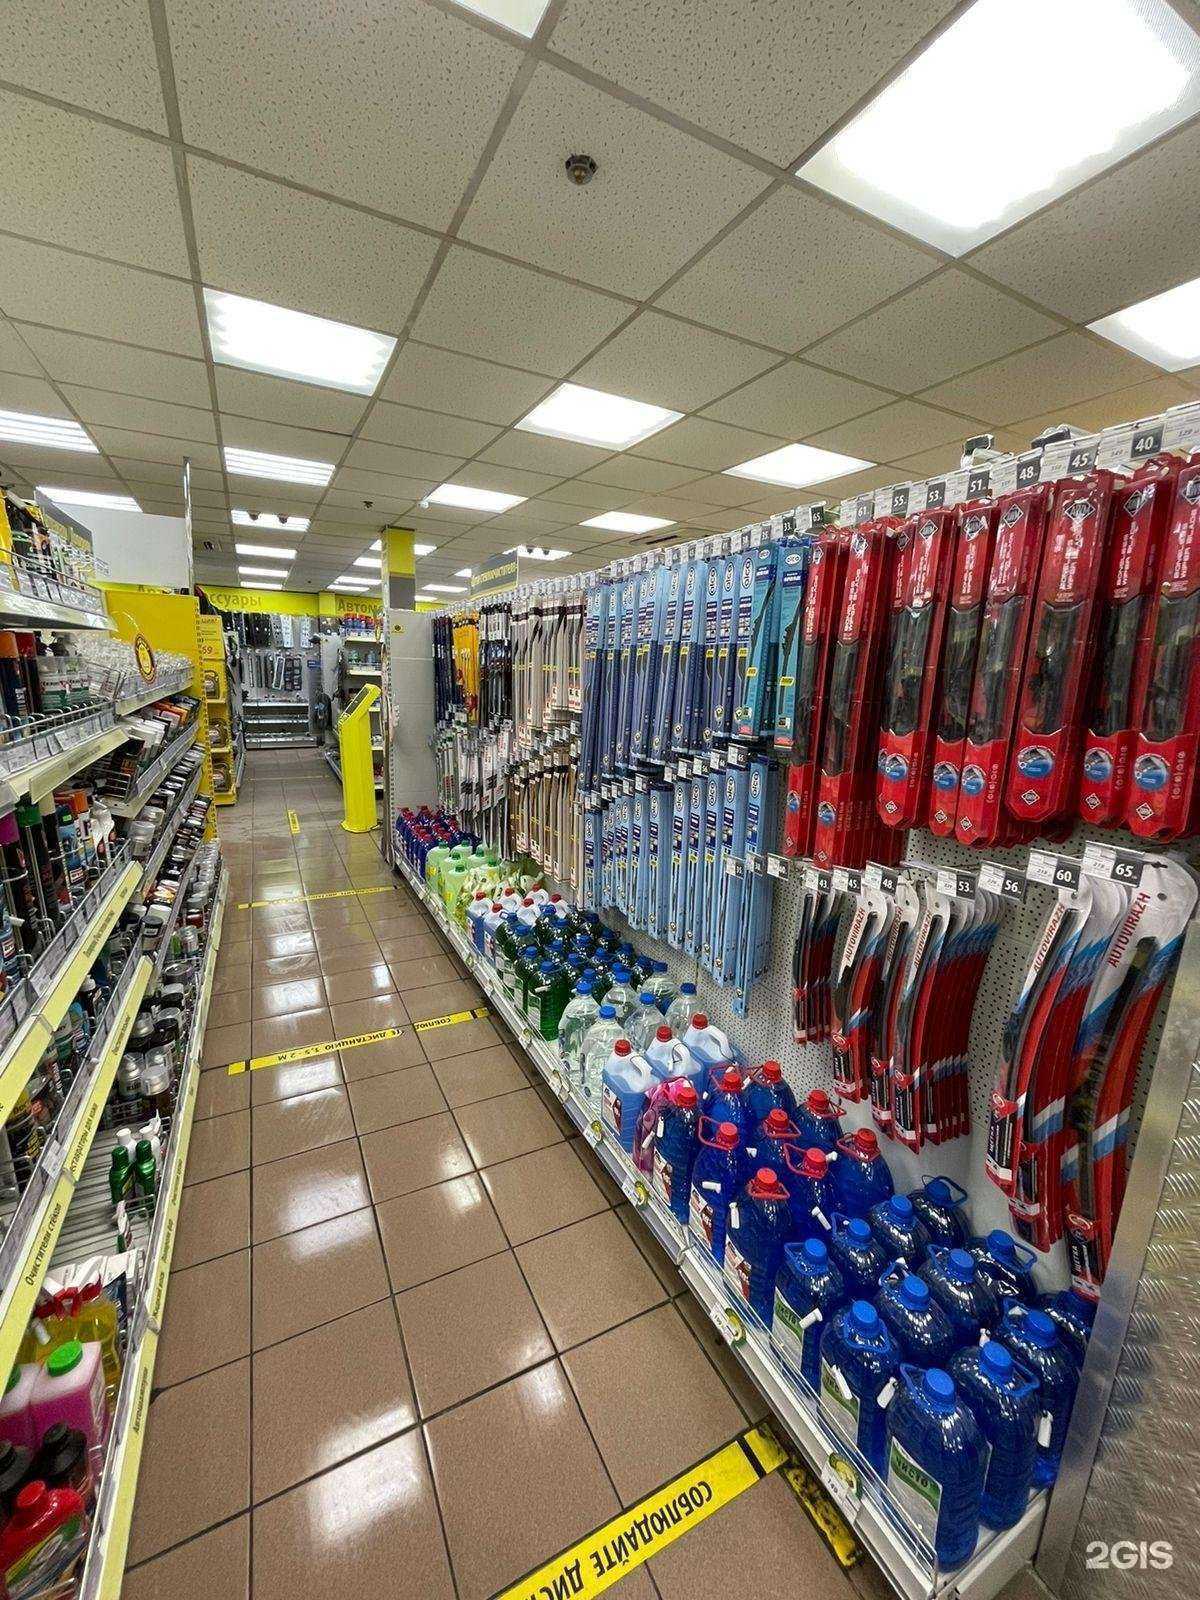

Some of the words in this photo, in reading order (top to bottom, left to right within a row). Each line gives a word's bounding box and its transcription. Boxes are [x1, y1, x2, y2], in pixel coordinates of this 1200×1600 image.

[1135, 436, 1154, 452] 40
[1072, 452, 1088, 467] 45
[1019, 465, 1034, 480] 48
[970, 480, 982, 493] 51
[893, 494, 904, 507] 55
[929, 489, 940, 503] 53
[858, 506, 867, 517] 61
[1057, 869, 1072, 883] 60
[1116, 863, 1133, 877] 65
[882, 878, 893, 889] 48
[957, 880, 970, 893] 53
[1005, 881, 1018, 893] 56
[1108, 892, 1151, 968] AUTOVIRAZH
[25, 1230, 51, 1286] Очистители
[589, 1480, 713, 1579] СОБЛЮДАЙТЕ
